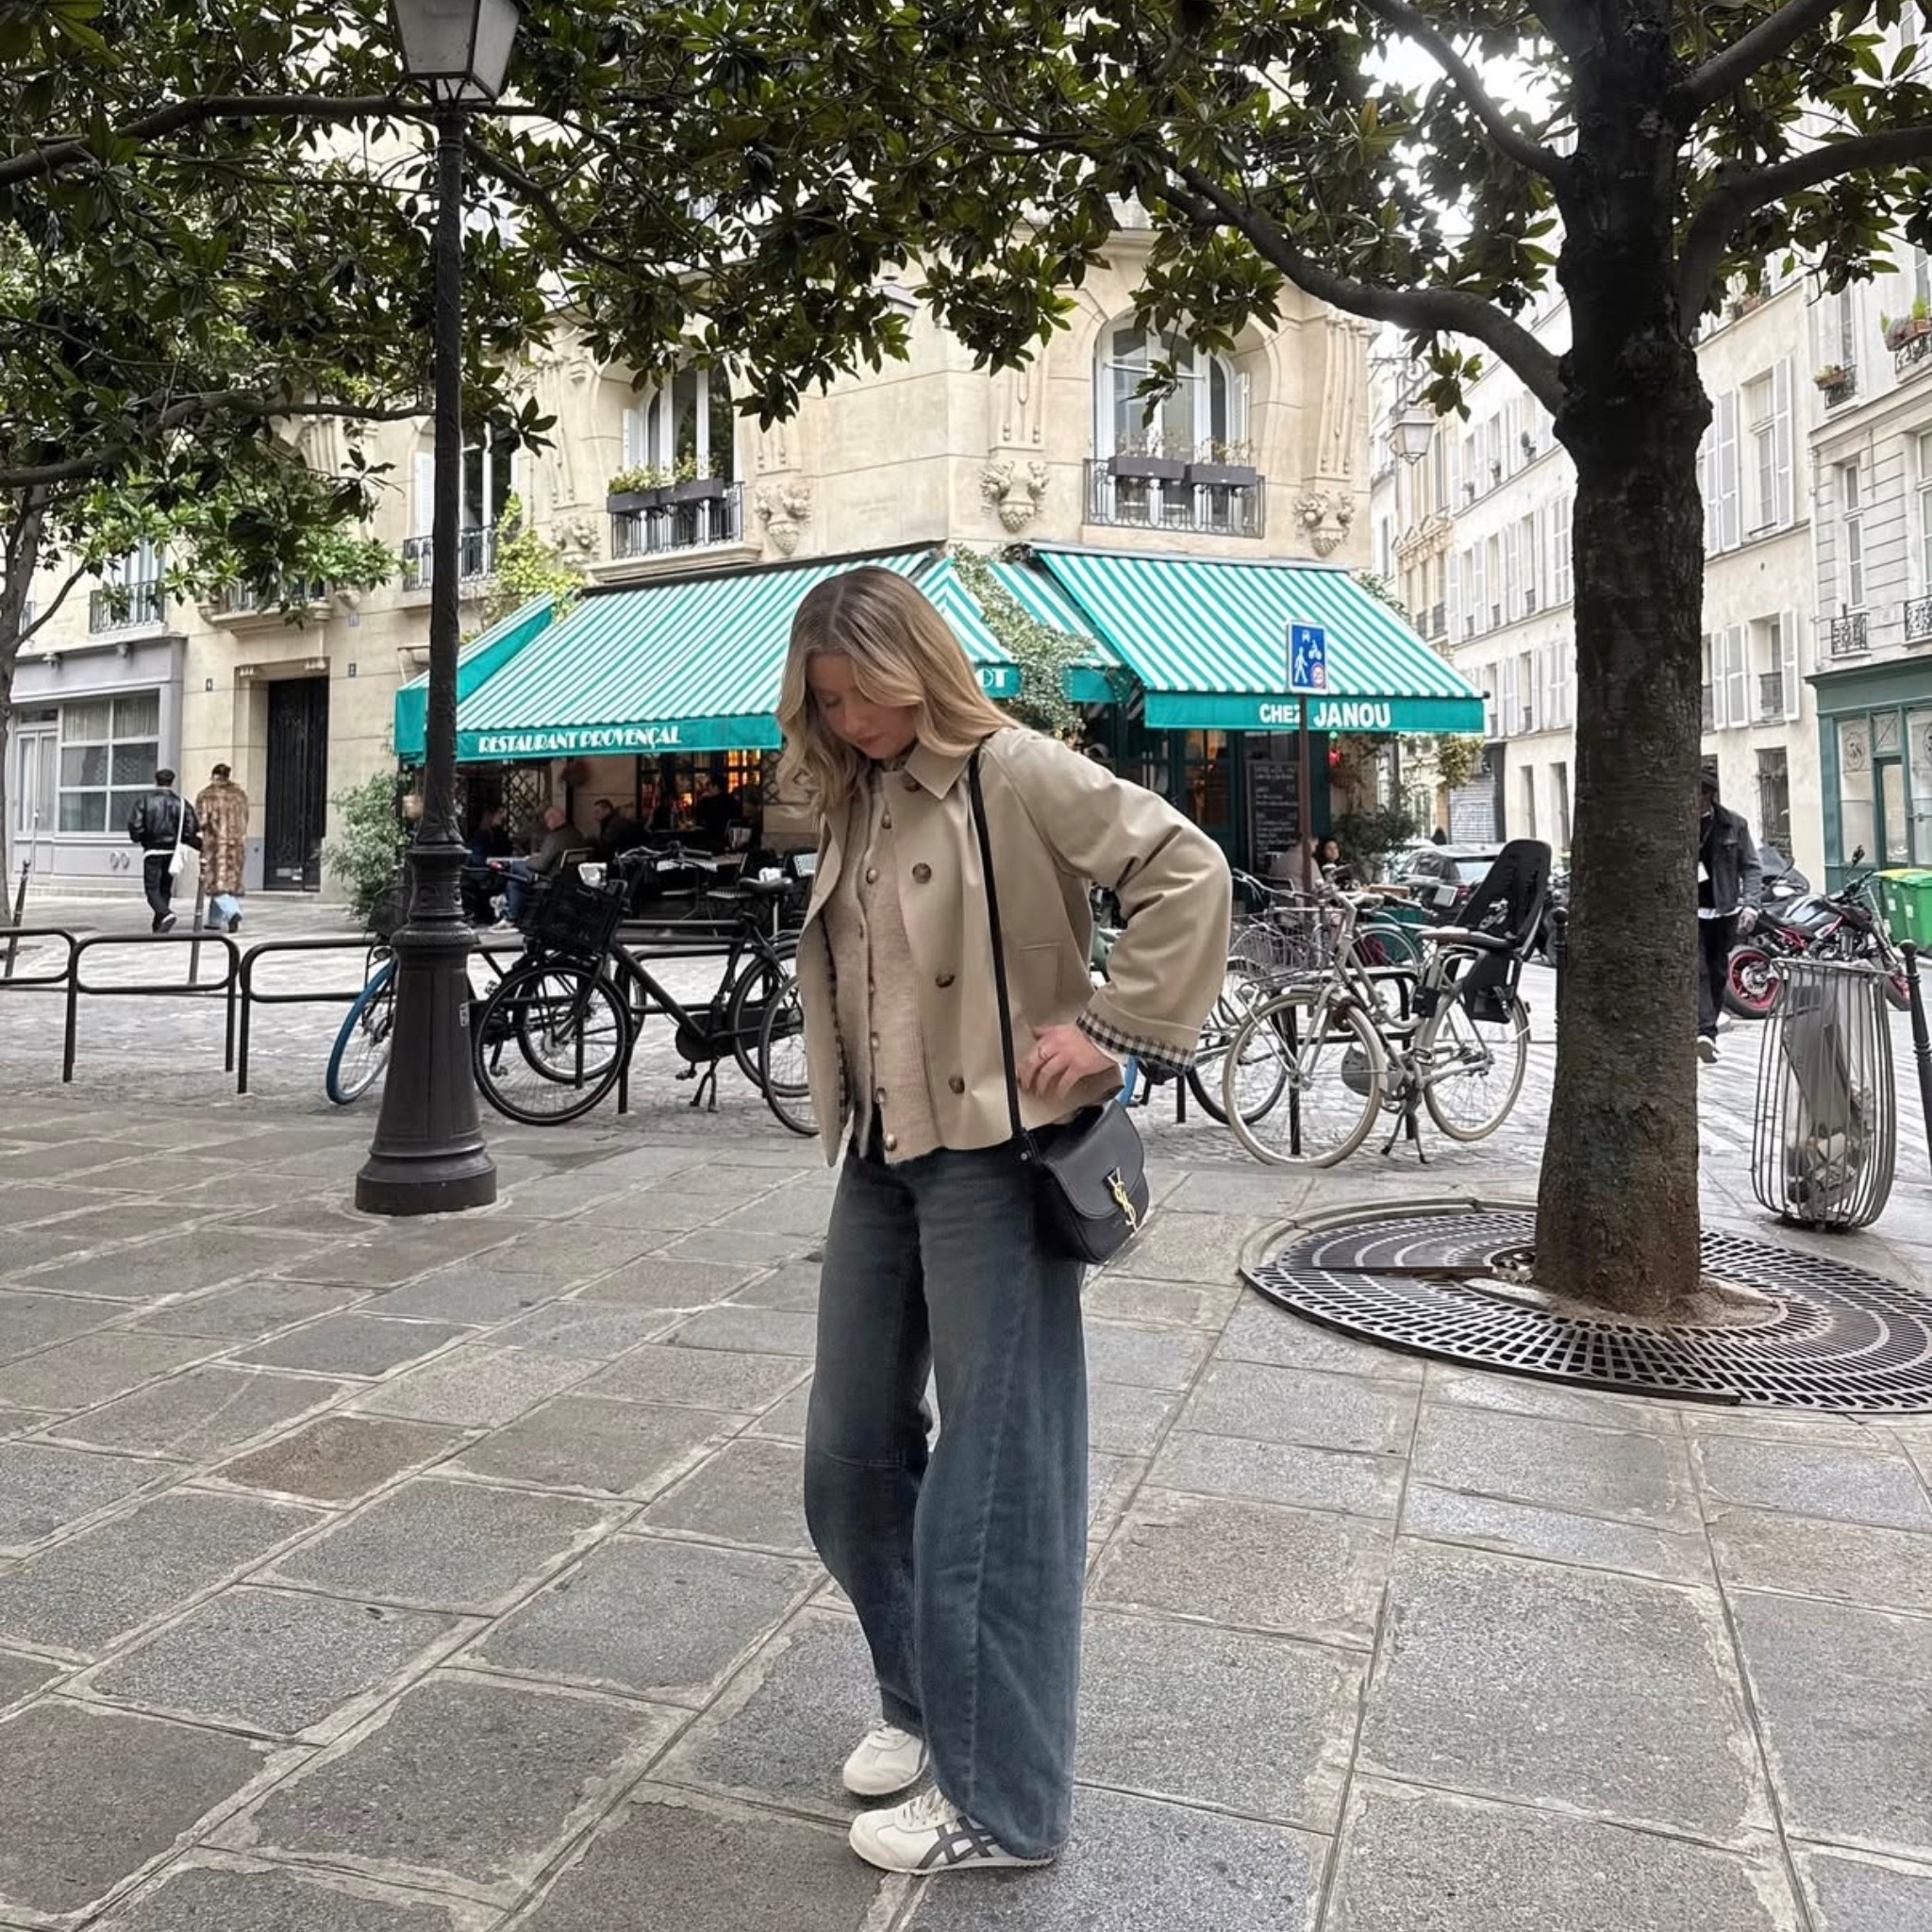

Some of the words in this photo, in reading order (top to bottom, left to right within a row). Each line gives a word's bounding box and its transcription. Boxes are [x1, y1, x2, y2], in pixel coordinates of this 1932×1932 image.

[1313, 701, 1391, 728] JANOU
[478, 732, 578, 753] RESTAURANT
[579, 725, 681, 750] PROVENÇAL
